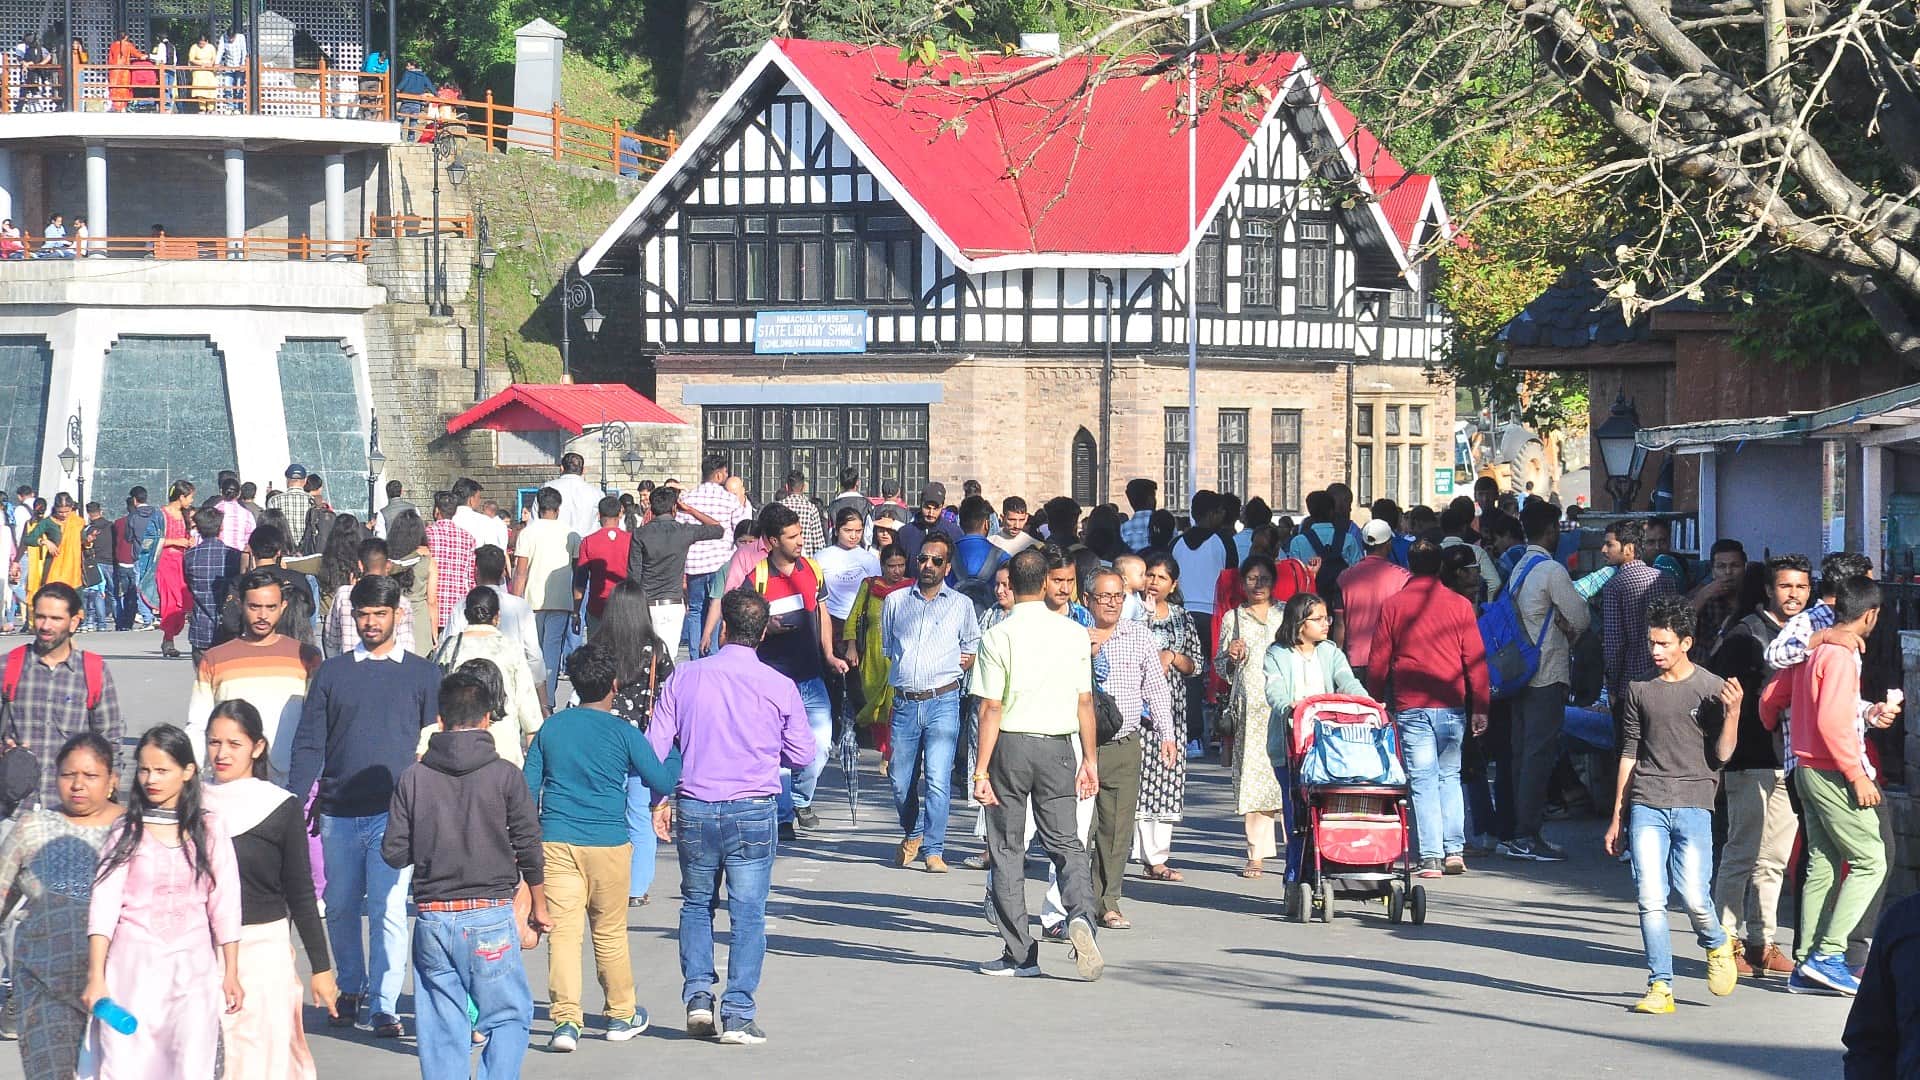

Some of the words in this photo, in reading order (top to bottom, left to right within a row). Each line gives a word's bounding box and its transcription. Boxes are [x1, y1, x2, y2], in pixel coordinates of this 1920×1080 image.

[758, 324, 785, 337] STATE
[787, 324, 826, 337] LIBRARY
[828, 323, 863, 337] SHIMLA
